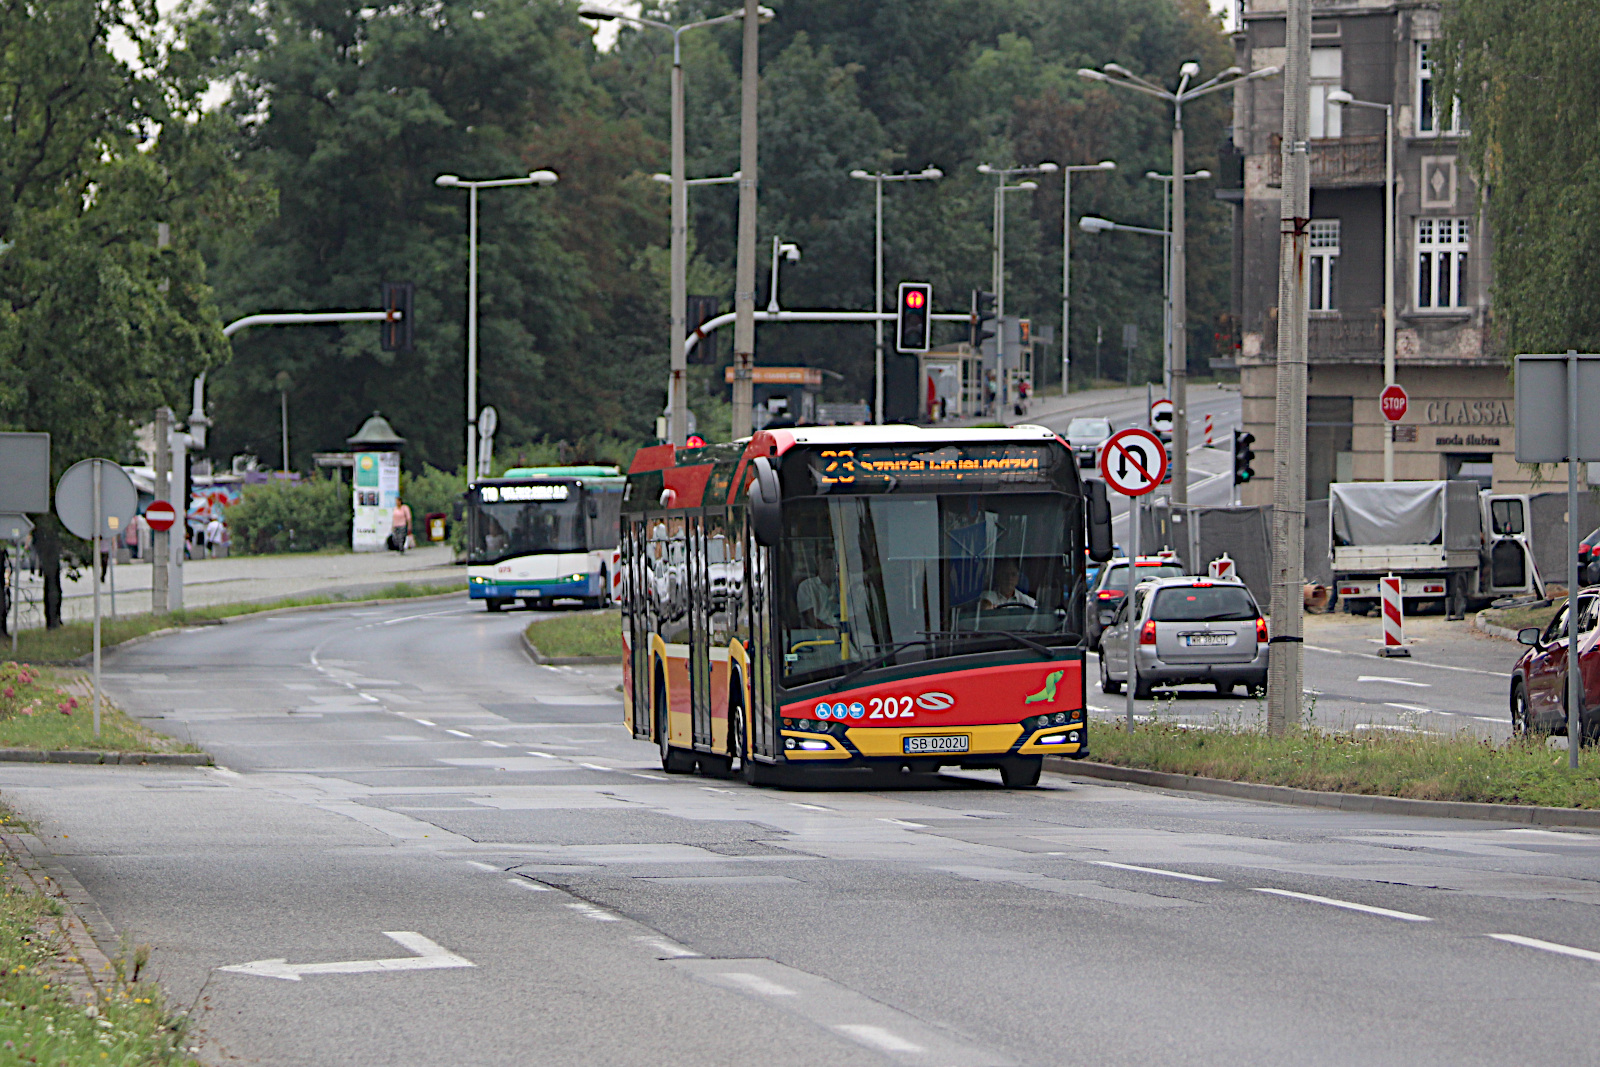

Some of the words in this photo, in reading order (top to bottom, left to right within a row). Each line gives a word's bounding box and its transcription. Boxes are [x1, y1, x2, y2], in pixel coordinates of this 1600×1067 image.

[1383, 397, 1405, 409] STOP
[1426, 401, 1510, 425] CLASSA
[1436, 434, 1463, 446] moda
[1465, 434, 1500, 446] ślubna
[821, 450, 855, 483] 23
[869, 696, 915, 719] 202
[911, 738, 927, 749] SB
[931, 737, 966, 748] 0202U
